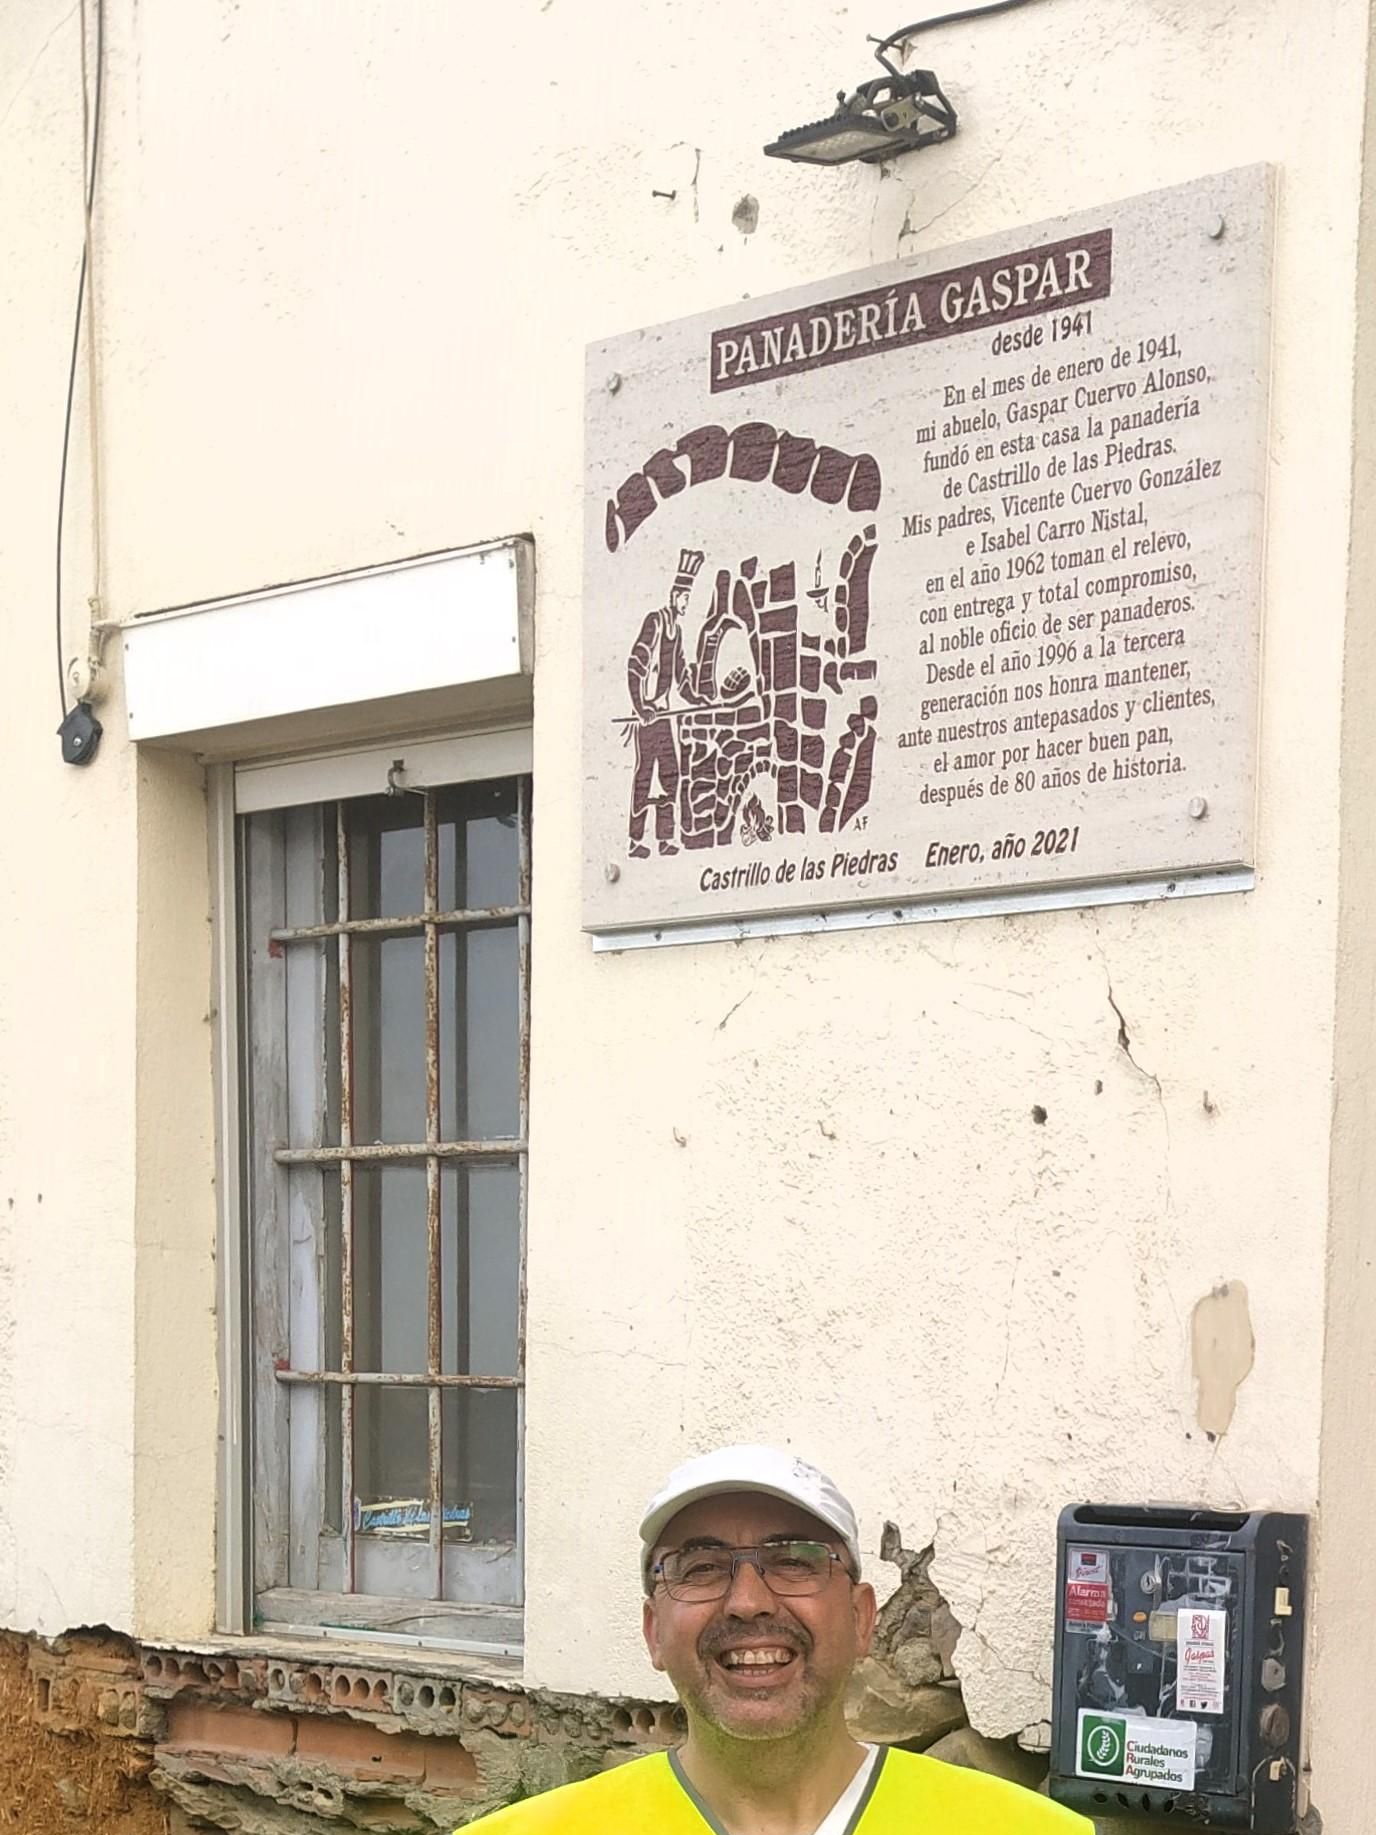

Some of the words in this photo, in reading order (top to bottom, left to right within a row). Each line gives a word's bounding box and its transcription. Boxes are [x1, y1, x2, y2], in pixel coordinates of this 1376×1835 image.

[716, 289, 925, 380] PANADERÍA
[940, 248, 1092, 323] GASPAR
[991, 323, 1043, 355] desde
[1051, 309, 1091, 342] 1941
[943, 384, 965, 407] En
[971, 377, 986, 400] el
[992, 375, 1024, 396] mes
[1031, 364, 1050, 387] de
[1057, 356, 1103, 381] enero
[1110, 346, 1130, 368] de
[1137, 333, 1181, 363] 1941,
[916, 426, 936, 444] mi
[942, 407, 1000, 438] abuelo,
[1006, 396, 1068, 423] Gaspar
[1074, 381, 1136, 408] Cuervo
[1142, 365, 1211, 394] Alonso,
[923, 445, 969, 472] fundó
[975, 444, 994, 461] en
[1000, 435, 1035, 456] esta
[1041, 425, 1080, 447] casa
[1087, 416, 1103, 438] la
[1109, 395, 1200, 439] panadería
[902, 514, 931, 537] Mis
[937, 504, 995, 536] padres,
[1001, 490, 1064, 517] Vicente
[1071, 478, 1132, 504] Cuervo
[1139, 457, 1220, 491] González
[943, 477, 961, 499] de
[967, 461, 1040, 494] Castrillo
[1046, 455, 1066, 477] de
[1073, 450, 1098, 472] las
[1104, 437, 1176, 466] Piedras.
[965, 540, 974, 556] e
[980, 523, 1030, 553] Isabel
[1037, 519, 1084, 542] Carro
[1091, 501, 1147, 532] Nistal,
[925, 576, 944, 593] en
[950, 566, 964, 589] el
[970, 562, 1000, 586] año
[1006, 552, 1044, 579] 1962
[1050, 547, 1104, 571] toman
[1111, 536, 1126, 560] el
[1133, 531, 1191, 556] relevo,
[919, 606, 947, 624] con
[953, 595, 1015, 619] entrega
[1021, 591, 1031, 613] y
[1038, 577, 1078, 604] total
[1085, 563, 1196, 597] compromiso,
[919, 632, 934, 655] al
[940, 625, 984, 652] noble
[990, 619, 1036, 643] oficio
[1042, 612, 1061, 635] de
[1067, 612, 1094, 631] ser
[1100, 595, 1195, 632] panaderos.
[926, 658, 974, 684] Desde
[980, 653, 994, 675] el
[1000, 650, 1031, 672] año
[1037, 641, 1076, 667] 1996
[1082, 644, 1092, 659] a
[1099, 635, 1116, 657] la
[1123, 628, 1184, 653] tercera
[897, 727, 931, 748] ante
[937, 718, 1007, 742] nuestros
[1013, 698, 1118, 733] antepasados
[1124, 700, 1132, 722] y
[1142, 688, 1215, 713] clientes,
[920, 688, 1007, 720] generación
[1014, 682, 1042, 701] nos
[1048, 674, 1097, 696] honra
[1105, 660, 1190, 687] mantener,
[933, 751, 947, 773] el
[953, 750, 995, 770] amor
[1001, 746, 1029, 770] por
[1035, 738, 1082, 759] hacer
[1088, 731, 1129, 752] buen
[1135, 727, 1172, 752] pan,
[919, 782, 983, 807] después
[989, 774, 1008, 795] de
[1014, 769, 1035, 792] 80
[1041, 767, 1080, 789] años
[1087, 761, 1106, 783] de
[1112, 756, 1186, 780] historia.
[699, 861, 770, 891] Castrillo
[775, 858, 795, 883] de
[800, 856, 825, 881] las
[830, 849, 898, 877] Piedras
[924, 841, 984, 867] Enero,
[991, 832, 1025, 860] año
[1030, 826, 1079, 856] 2021
[1125, 1765, 1183, 1783] Agrupados
[1126, 1740, 1189, 1759] Ciudadanos
[1126, 1752, 1166, 1768] Rurales
